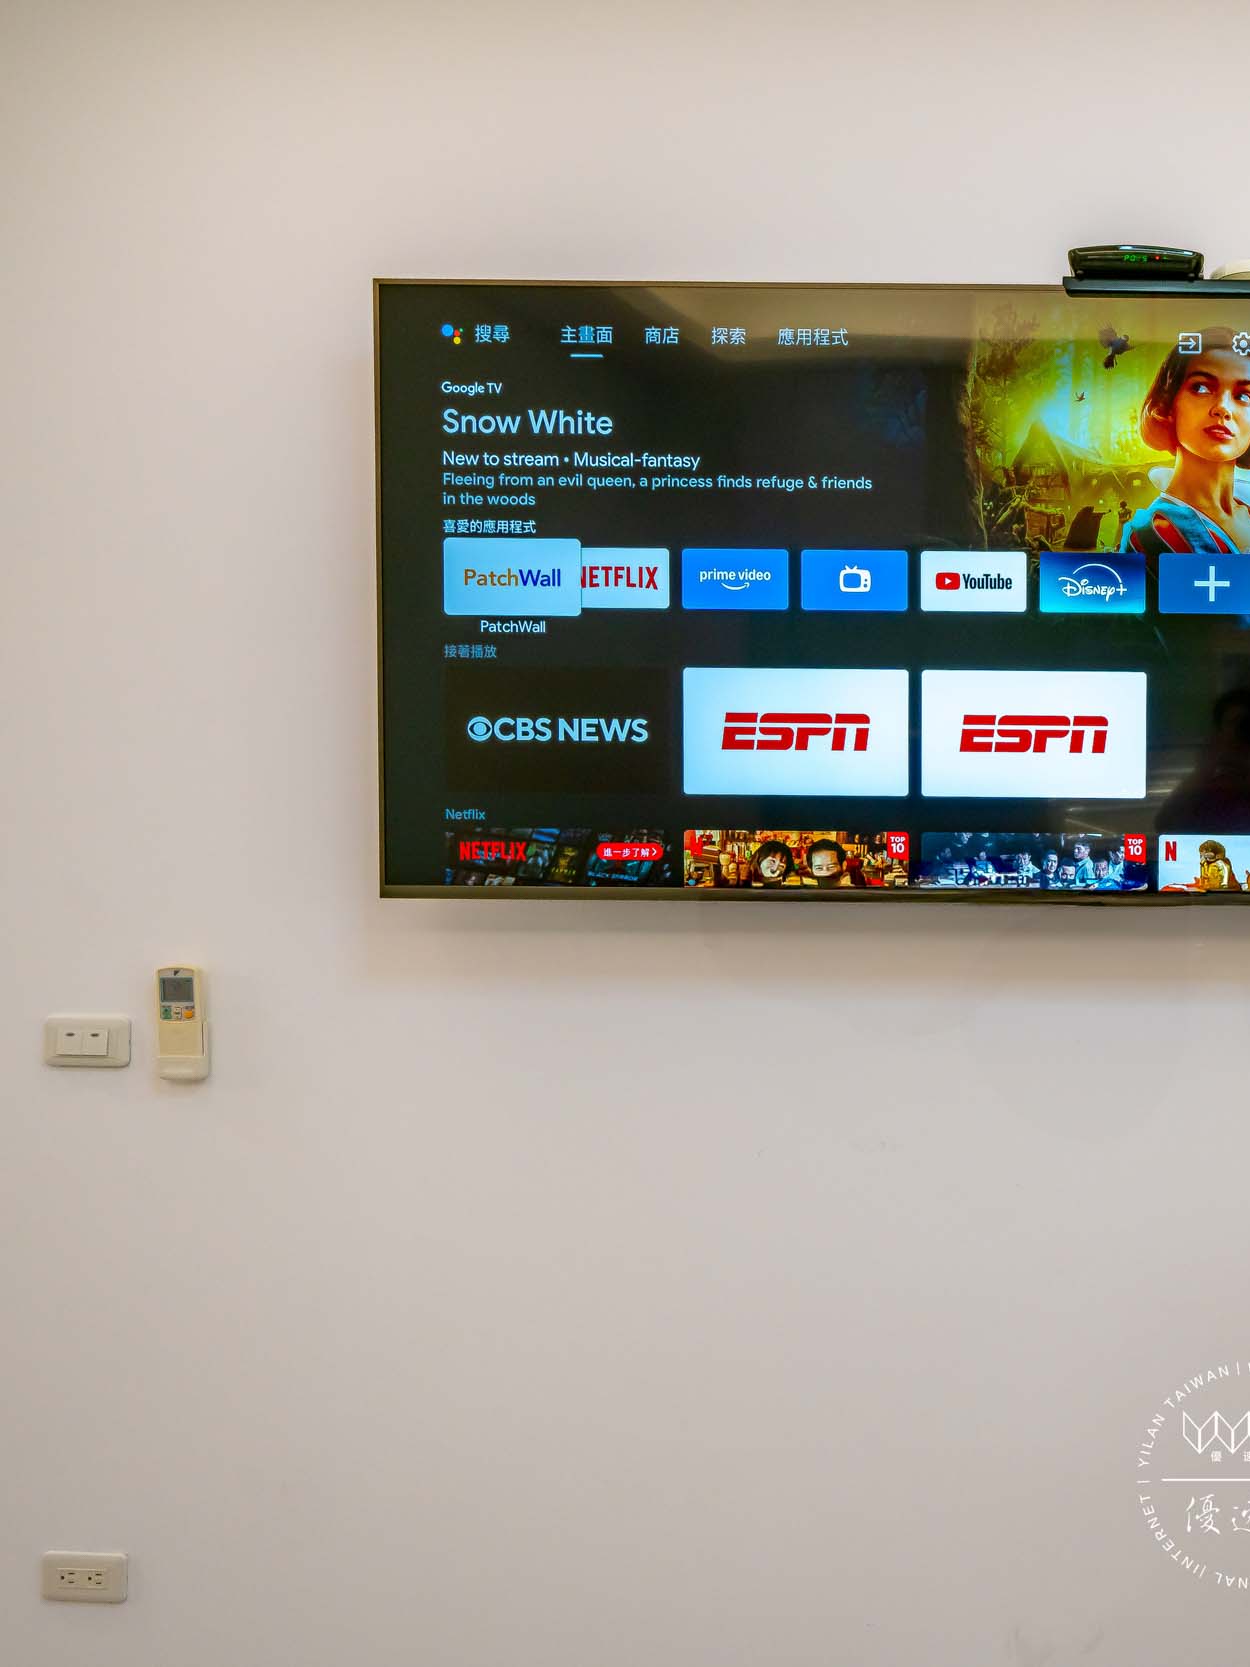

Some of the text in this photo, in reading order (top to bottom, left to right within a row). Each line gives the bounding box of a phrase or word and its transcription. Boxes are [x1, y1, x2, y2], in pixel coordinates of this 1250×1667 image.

[474, 324, 510, 344] 搜尋
[560, 325, 613, 345] 主畫面
[644, 326, 680, 345] 商店
[711, 326, 747, 346] 探索
[777, 327, 849, 348] 應用程式
[441, 381, 502, 397] Google TV
[442, 408, 614, 436] Snow White
[442, 451, 700, 472] New to stream Musical-fantasy
[443, 472, 873, 494] Fleeing from an evil queen, a princess finds refuge & friends
[443, 492, 536, 506] in the woods
[442, 519, 537, 535] 喜愛的應用程式
[463, 567, 562, 588] PatchWall
[699, 568, 772, 583] prime video
[962, 573, 1013, 590] YouTube
[480, 619, 546, 634] PatchWall
[493, 716, 650, 743] CBS NEWS
[720, 712, 871, 752] ESPN
[958, 713, 1110, 754] ESPN
[445, 809, 486, 821] Netflix
[459, 841, 527, 862] NETFLIX
[891, 843, 905, 853] 10
[1129, 845, 1142, 856] 10
[1165, 841, 1177, 861] N
